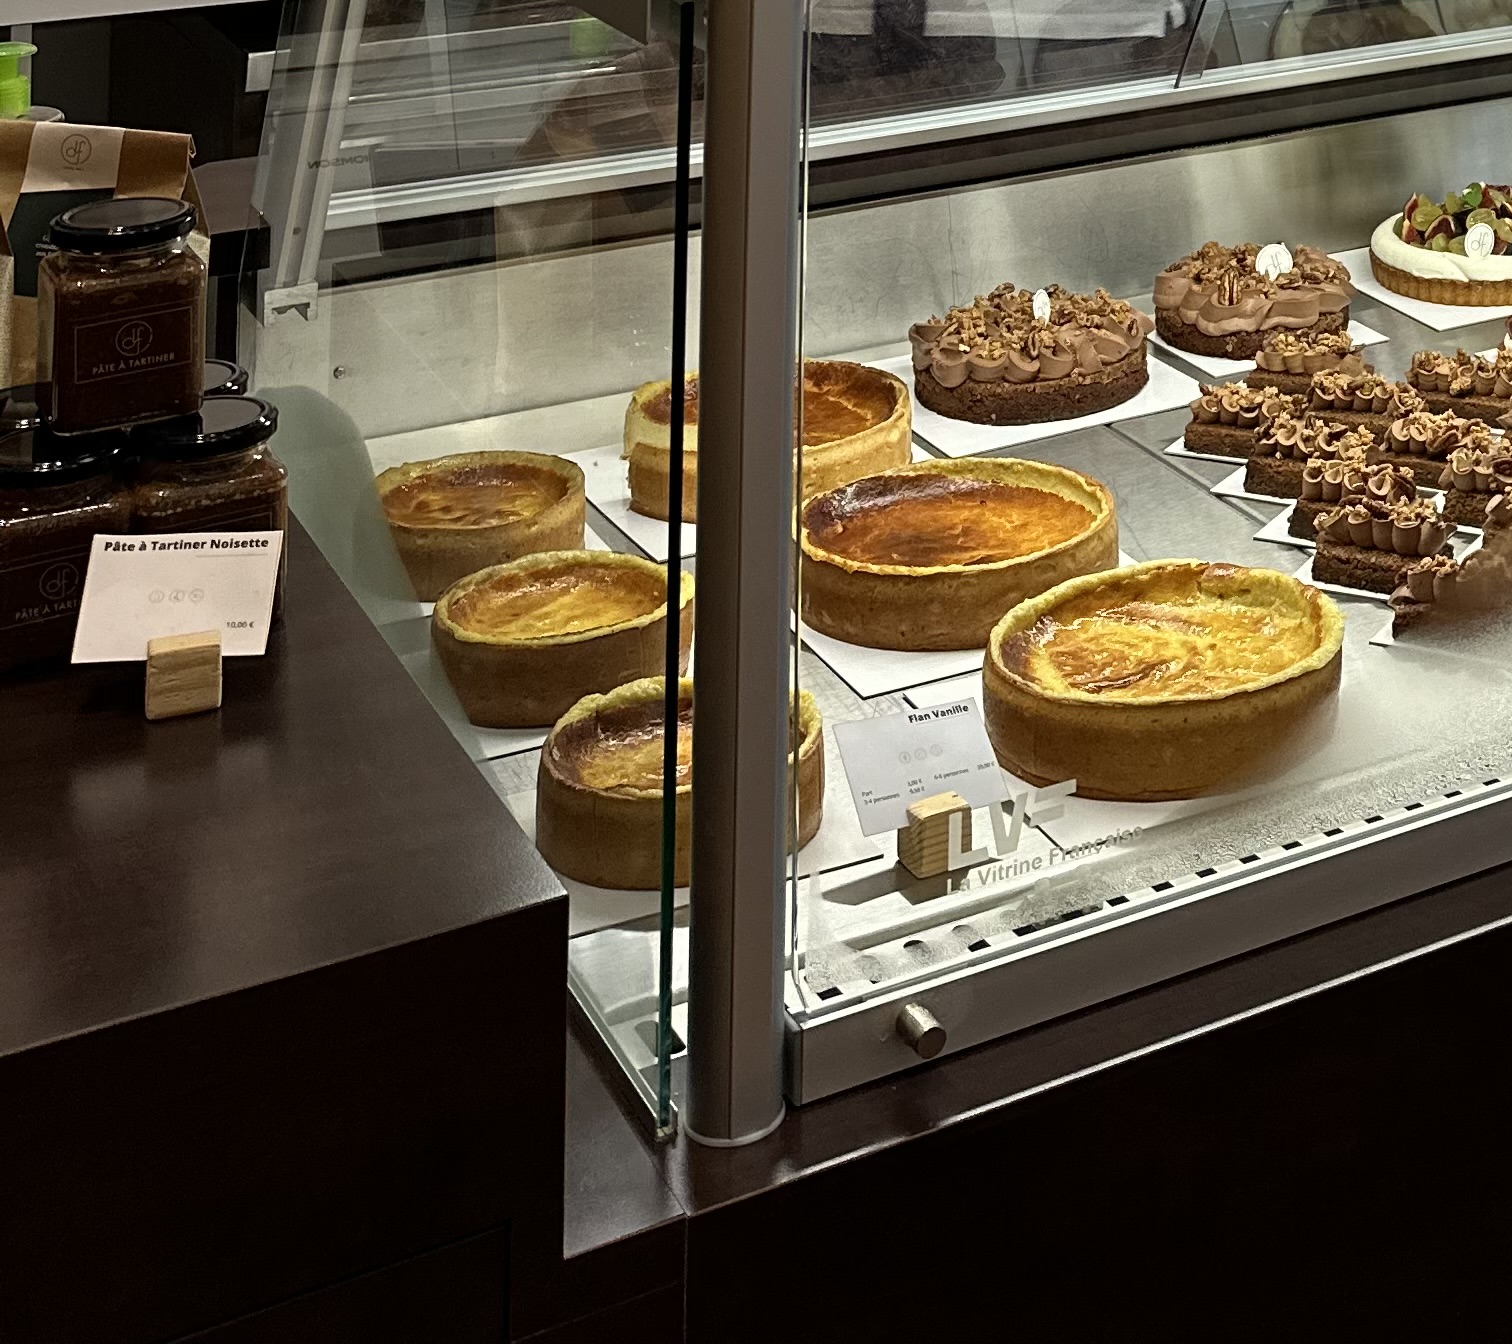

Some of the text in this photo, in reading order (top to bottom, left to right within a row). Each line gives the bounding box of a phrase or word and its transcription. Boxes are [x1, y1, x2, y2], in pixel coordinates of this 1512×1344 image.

[91, 351, 176, 376] PÂTE À TARTINER
[103, 537, 270, 552] Pâte à Tartiner Noisette
[907, 704, 970, 724] Flan Vanille
[946, 825, 1145, 895] La Vitrine Française
